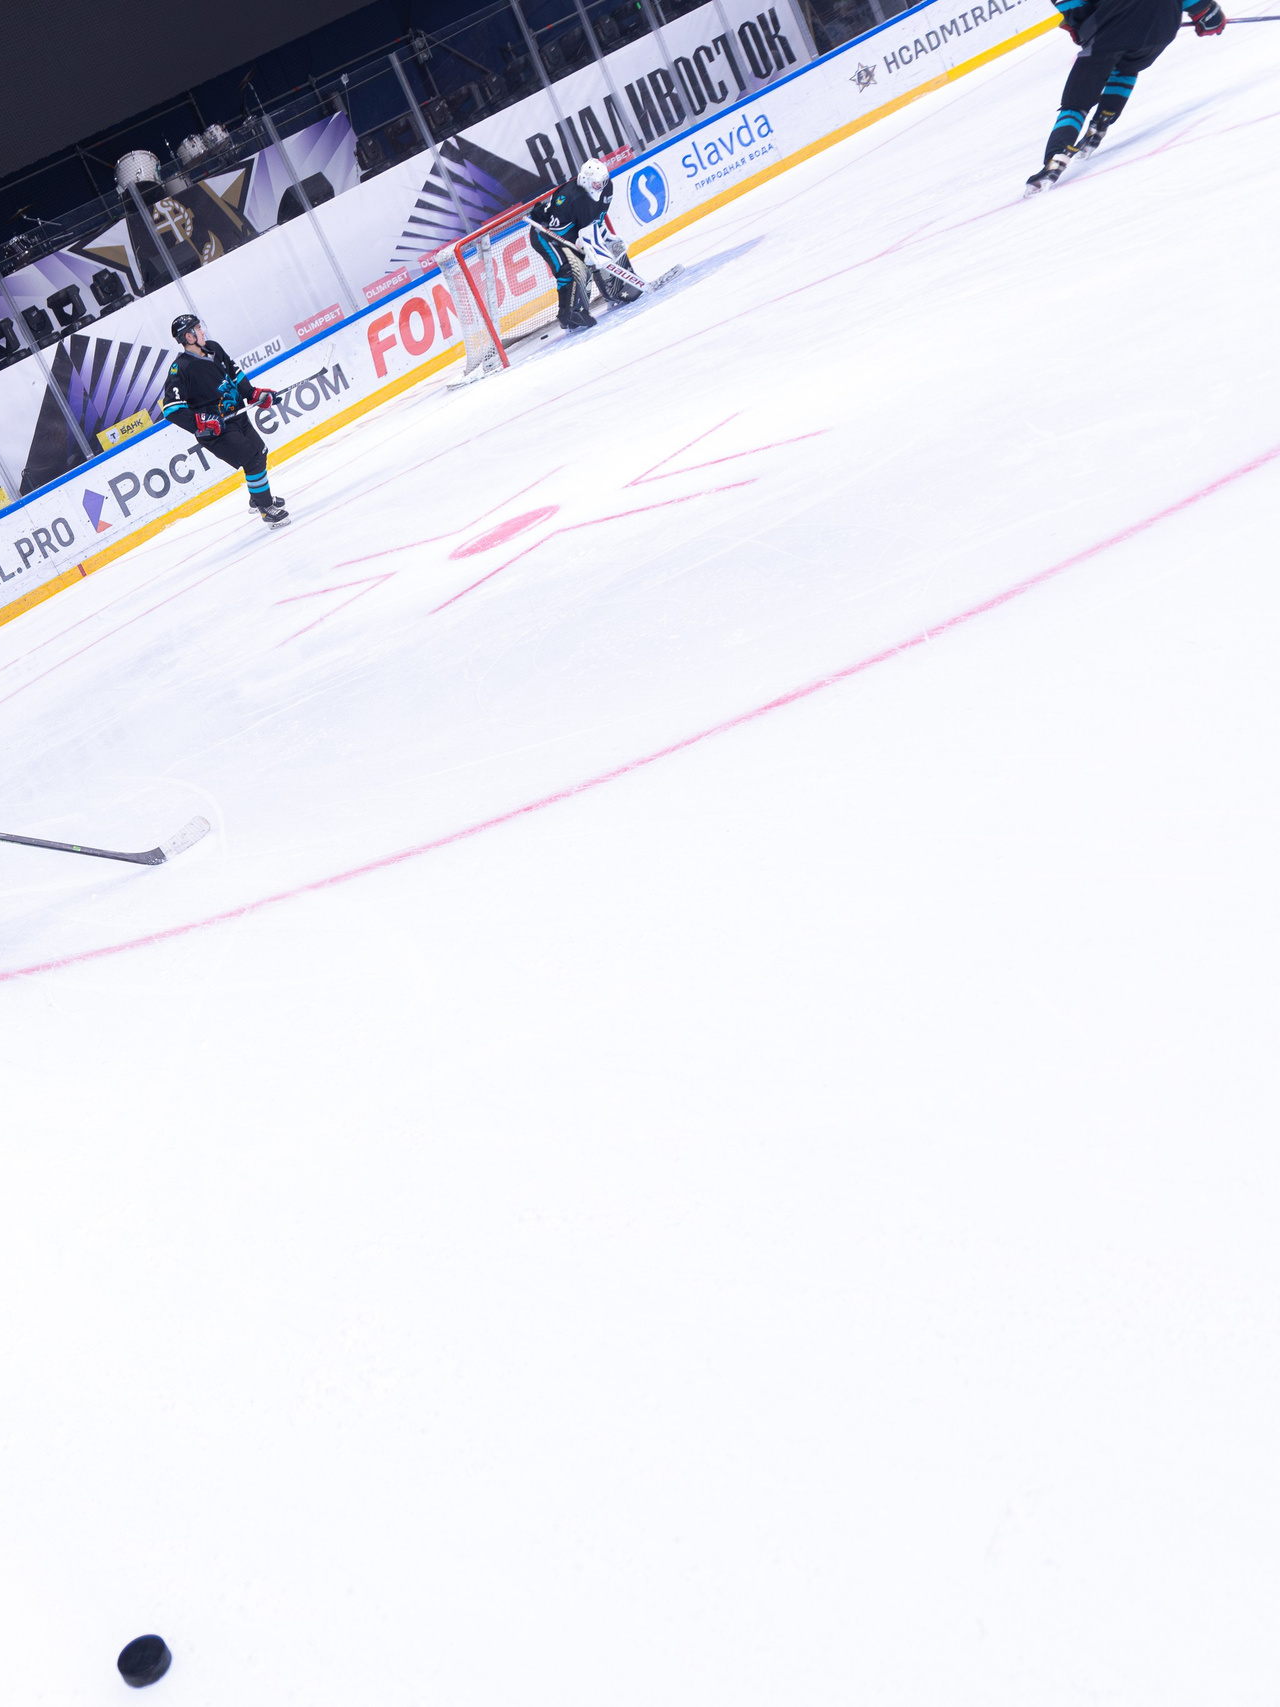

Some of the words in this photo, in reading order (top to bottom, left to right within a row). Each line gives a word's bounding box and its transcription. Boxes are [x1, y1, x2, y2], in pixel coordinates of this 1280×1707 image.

[525, 7, 797, 186] ВЛАДИВОСТОК
[682, 113, 774, 178] slavda
[694, 157, 747, 190] ПРИРОДНАЯ
[748, 143, 774, 161] ВОДА
[365, 270, 409, 300] OLIMPBET
[297, 307, 342, 338] OLIMPBET
[367, 236, 554, 379] FONBE
[240, 339, 282, 371] KHL.RU
[172, 386, 181, 400] 3
[108, 363, 350, 518] Ростеком
[120, 418, 144, 435] БАНК
